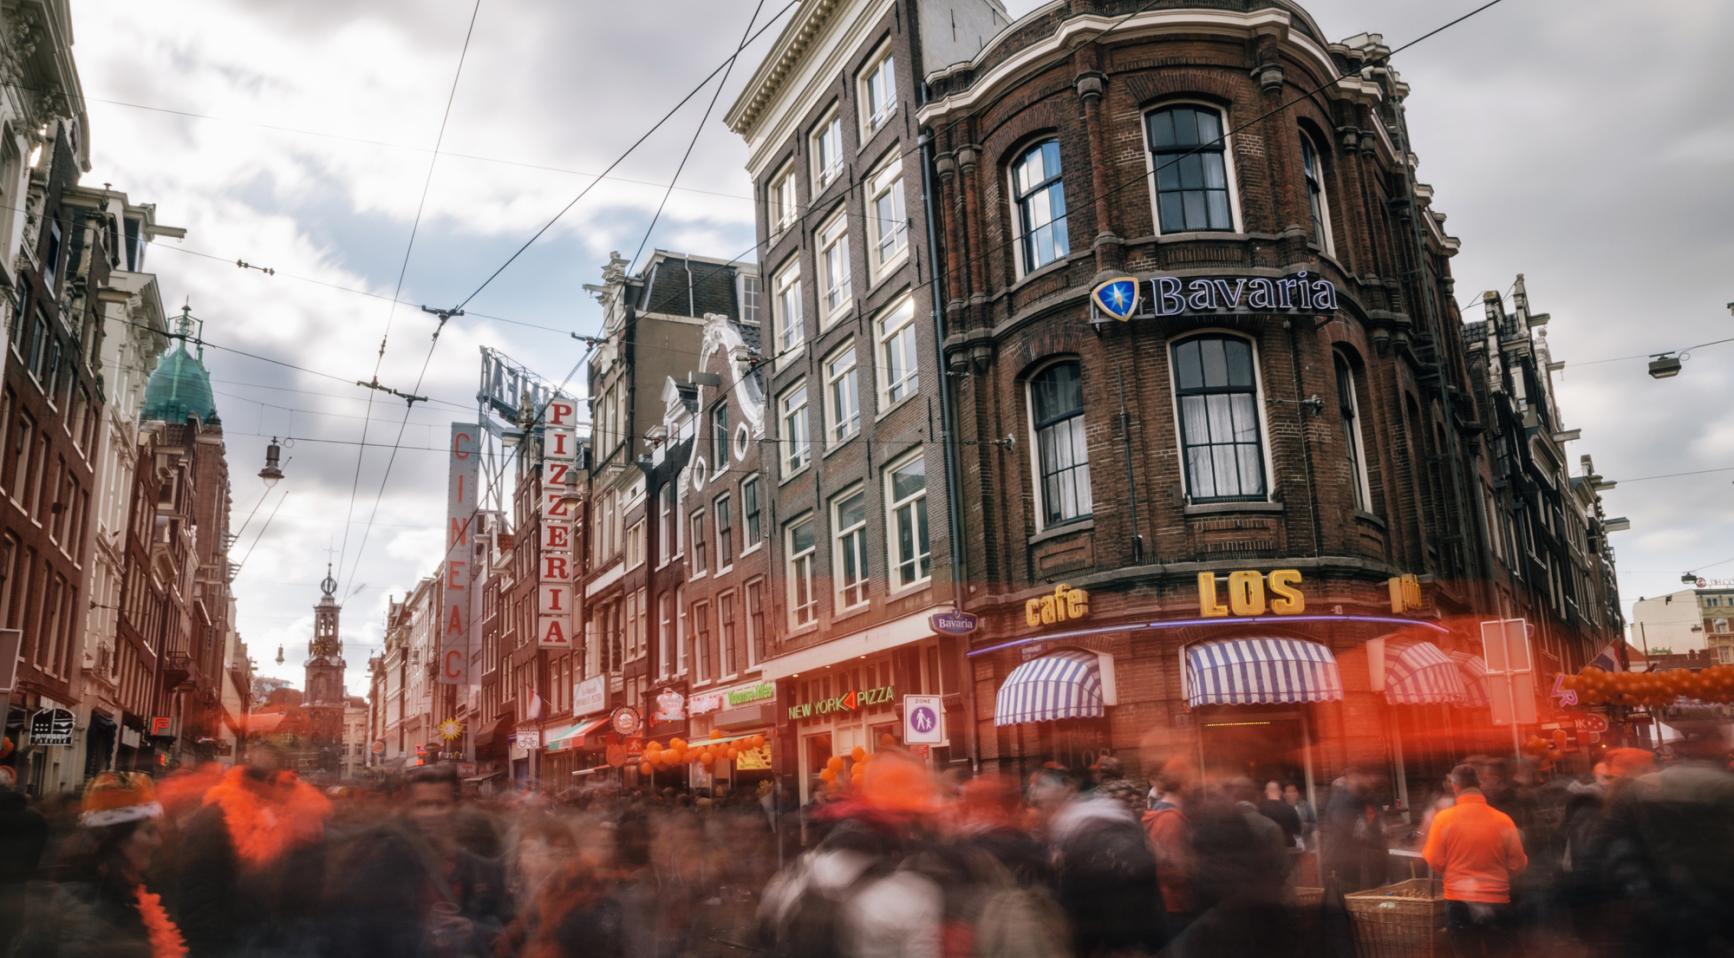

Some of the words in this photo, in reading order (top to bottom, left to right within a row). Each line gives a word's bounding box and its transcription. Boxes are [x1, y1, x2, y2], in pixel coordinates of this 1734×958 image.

[1150, 271, 1339, 317] Bavaria
[543, 403, 573, 643] PIZZERIA
[444, 432, 471, 679] CINEAC
[1198, 569, 1305, 617] LOS
[938, 618, 974, 629] Bavaria
[788, 703, 812, 720] NEW
[814, 692, 849, 715] YORK
[857, 685, 895, 707] PIZZA
